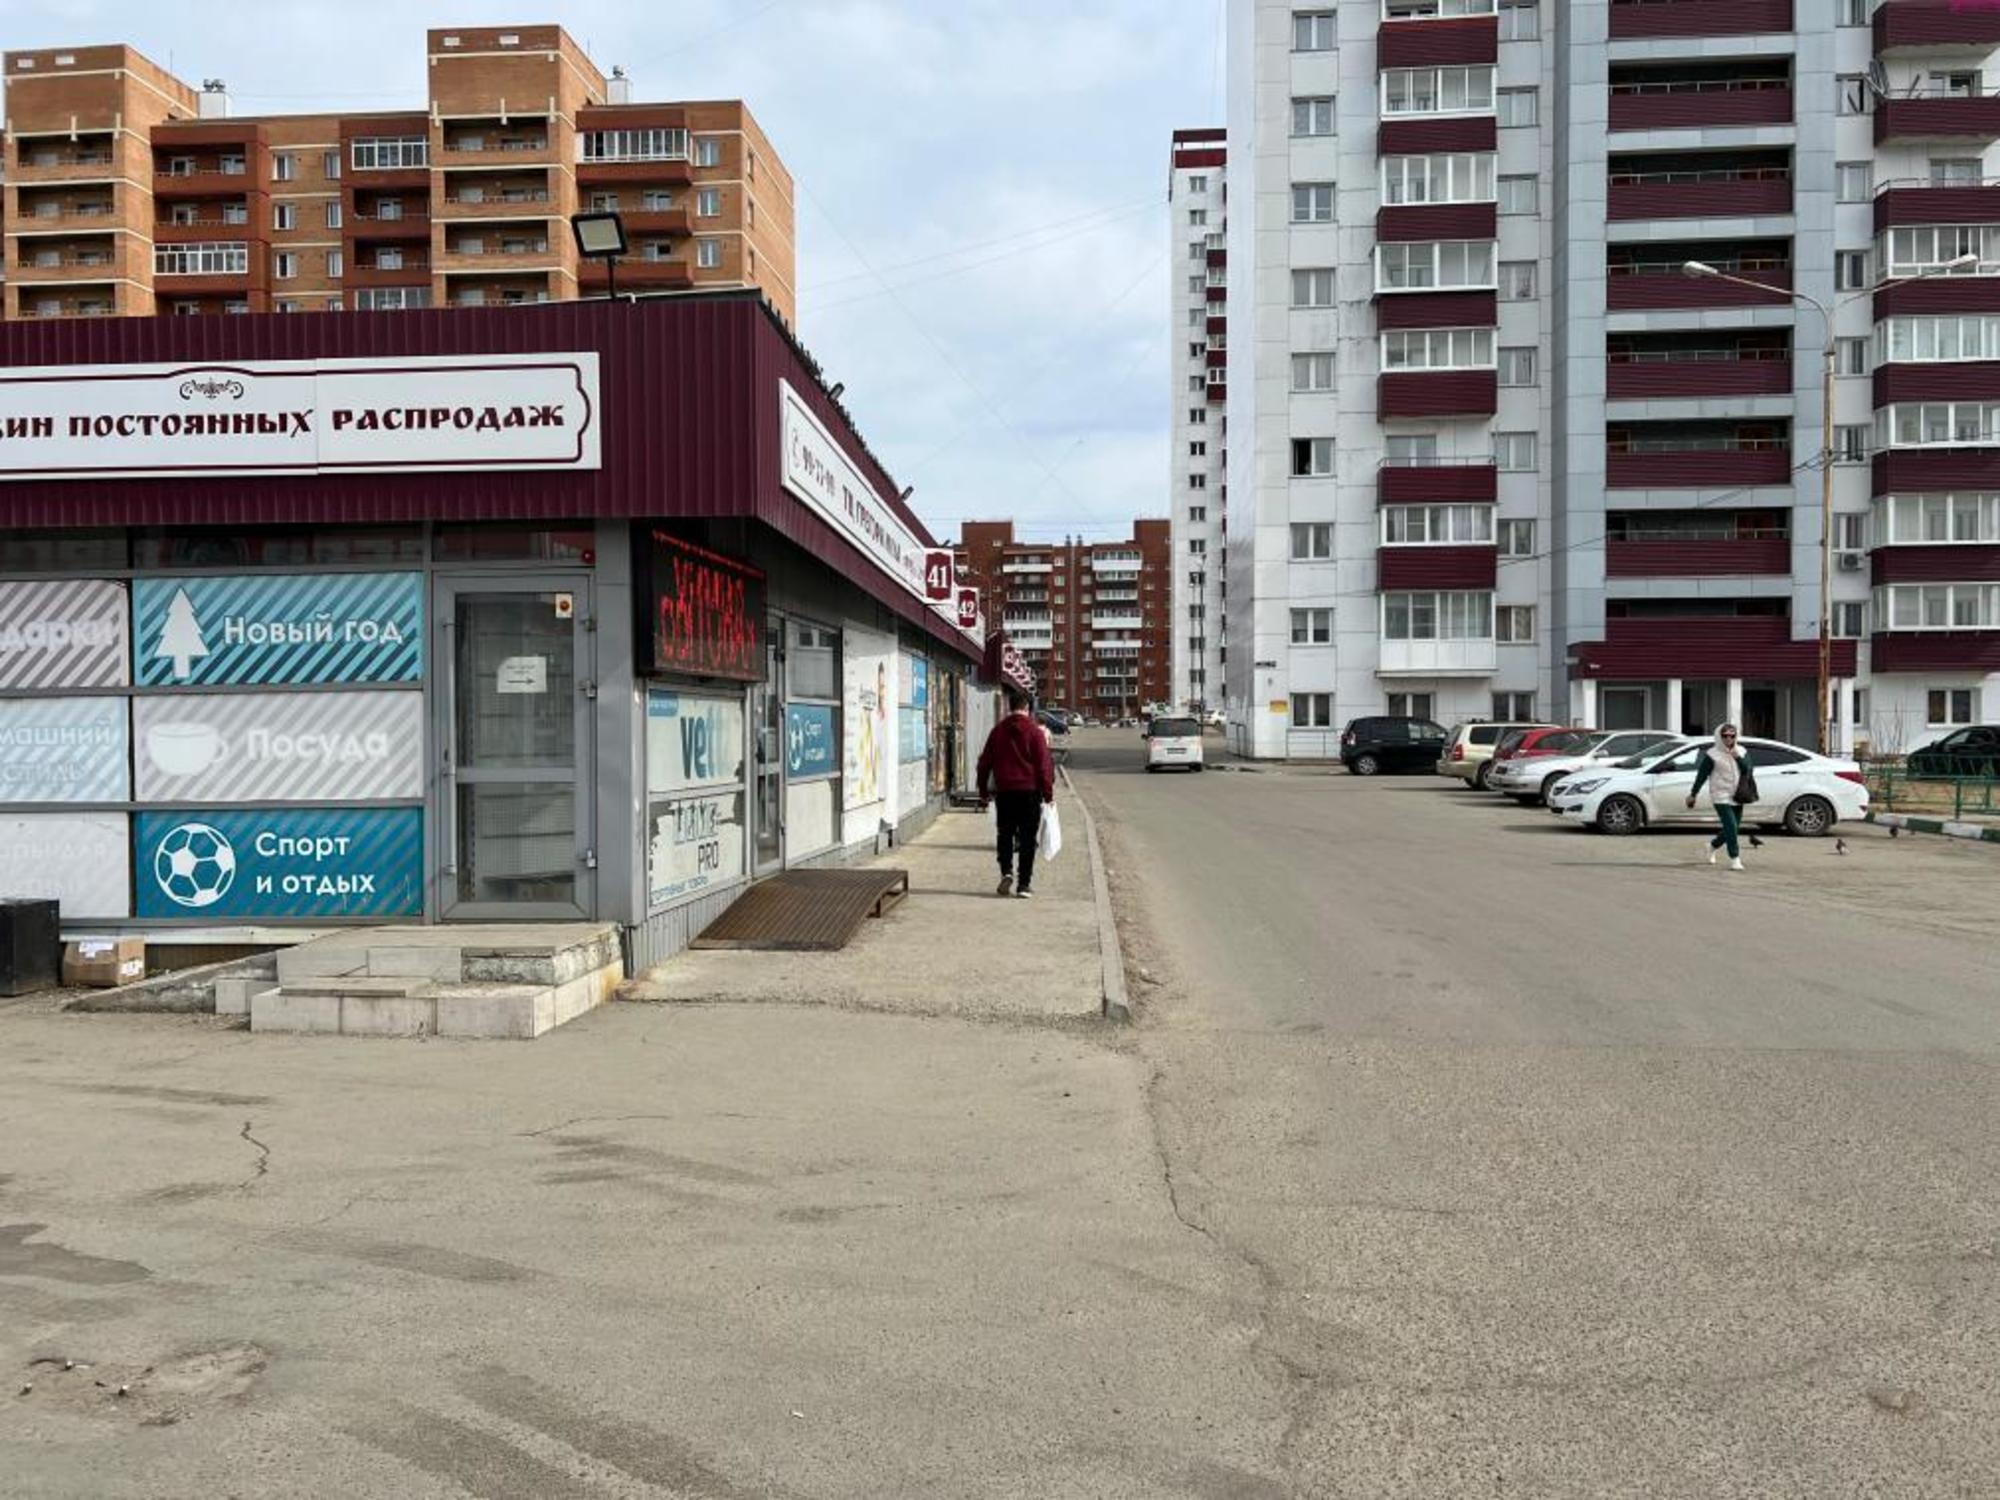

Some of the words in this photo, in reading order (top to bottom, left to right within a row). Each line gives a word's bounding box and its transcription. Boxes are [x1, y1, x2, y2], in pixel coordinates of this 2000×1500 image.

[0, 417, 54, 438] ИН
[70, 412, 313, 438] ПОСТОЯННЫХ
[332, 405, 567, 433] РАСПРОДАЖ
[928, 564, 949, 588] 41
[960, 600, 976, 618] 42
[223, 612, 333, 646] Новый
[345, 620, 403, 645] год
[246, 727, 388, 765] Посуда
[256, 832, 352, 857] Спорт
[256, 874, 273, 894] и
[281, 874, 376, 894] отдых
